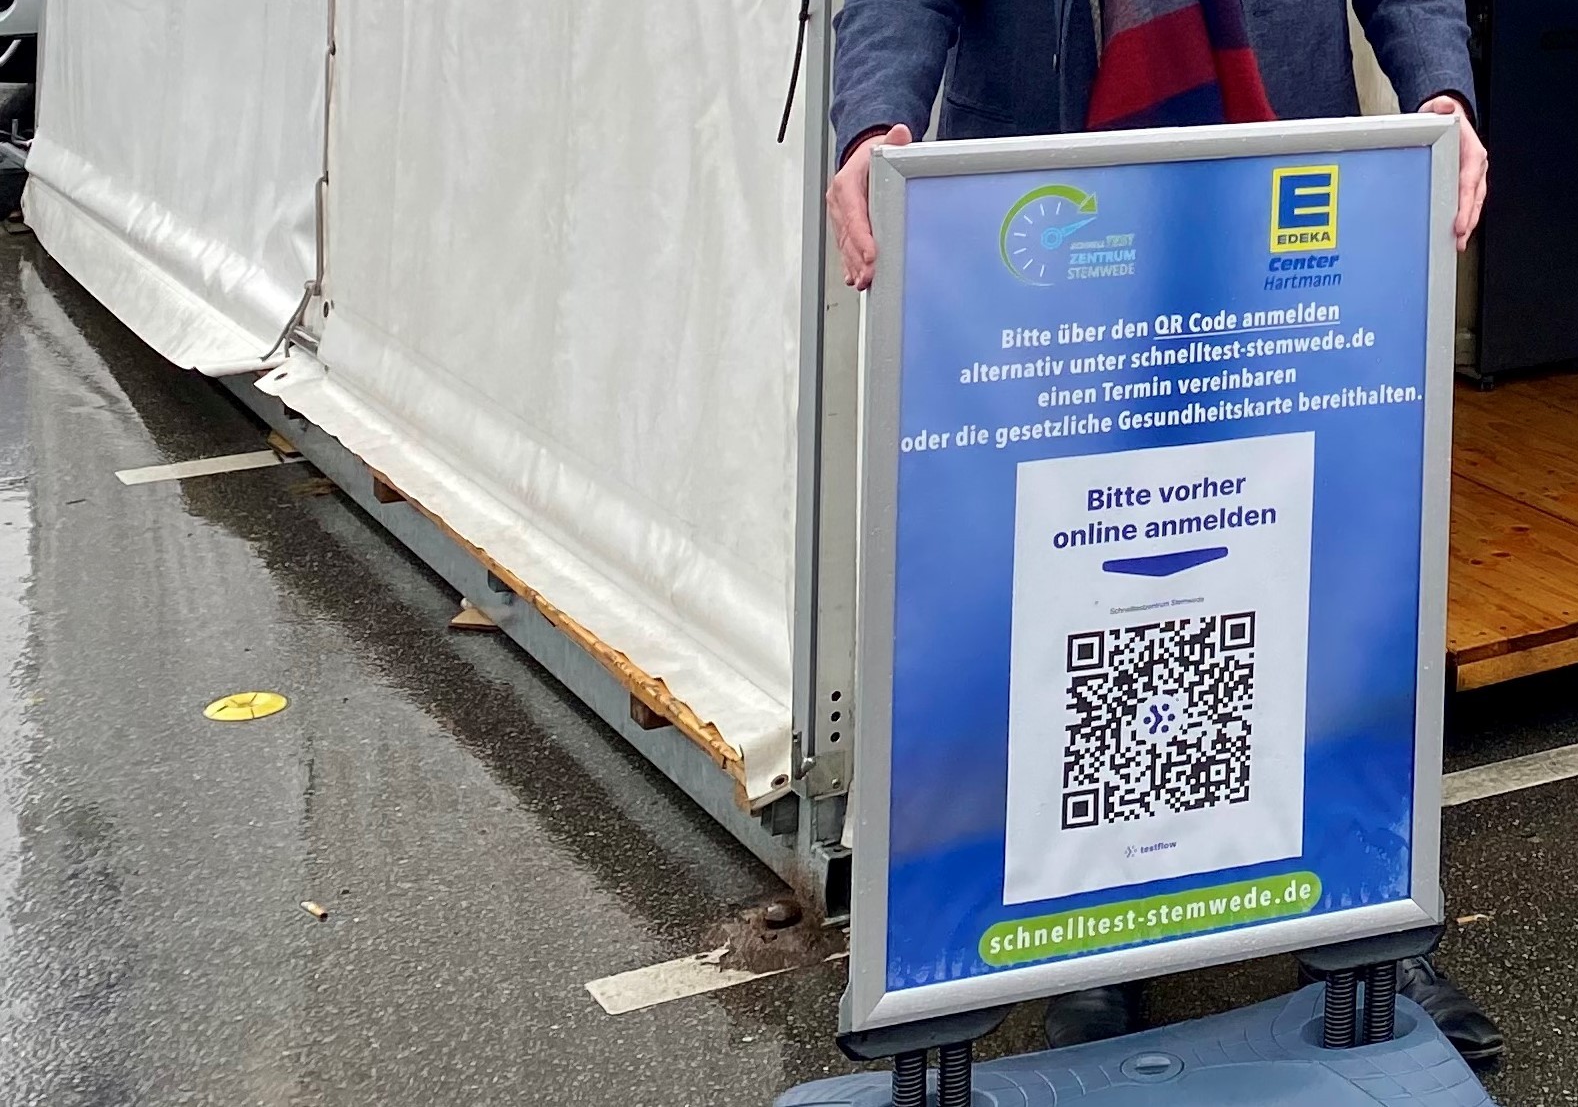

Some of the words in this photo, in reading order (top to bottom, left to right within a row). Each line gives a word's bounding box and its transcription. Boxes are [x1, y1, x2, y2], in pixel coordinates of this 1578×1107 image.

[1278, 173, 1332, 230] E
[1069, 249, 1137, 265] ZENTRUM
[1277, 231, 1332, 246] EDEKA
[1067, 262, 1136, 280] STEMWEDE
[1263, 273, 1342, 291] Hartmann
[1268, 254, 1340, 273] Center
[1001, 328, 1051, 349] Bitte
[1057, 322, 1106, 345] über
[1111, 318, 1148, 340] den
[1154, 313, 1183, 336] QR
[1188, 309, 1237, 333] Code
[1241, 301, 1340, 328] anmelden
[959, 357, 1064, 385] alternativ
[1069, 352, 1126, 375] unter
[1130, 326, 1375, 369] schnelltest-stemwede.de
[1037, 386, 1097, 408] einen
[1101, 375, 1172, 403] Termin
[1177, 366, 1297, 395] vereinbaren
[901, 429, 951, 453] oder
[955, 424, 989, 447] die
[995, 412, 1113, 449] gesetzliche
[1117, 396, 1293, 432] Gesundheitskarte
[1298, 383, 1423, 413] bereithalten.
[1087, 485, 1151, 512] Bitte
[1158, 476, 1247, 504] vorher
[1052, 521, 1138, 550] online
[1144, 505, 1277, 539] anmelden
[1140, 841, 1177, 854] testflow
[988, 879, 1312, 956] schnelltest-stemwede.de
